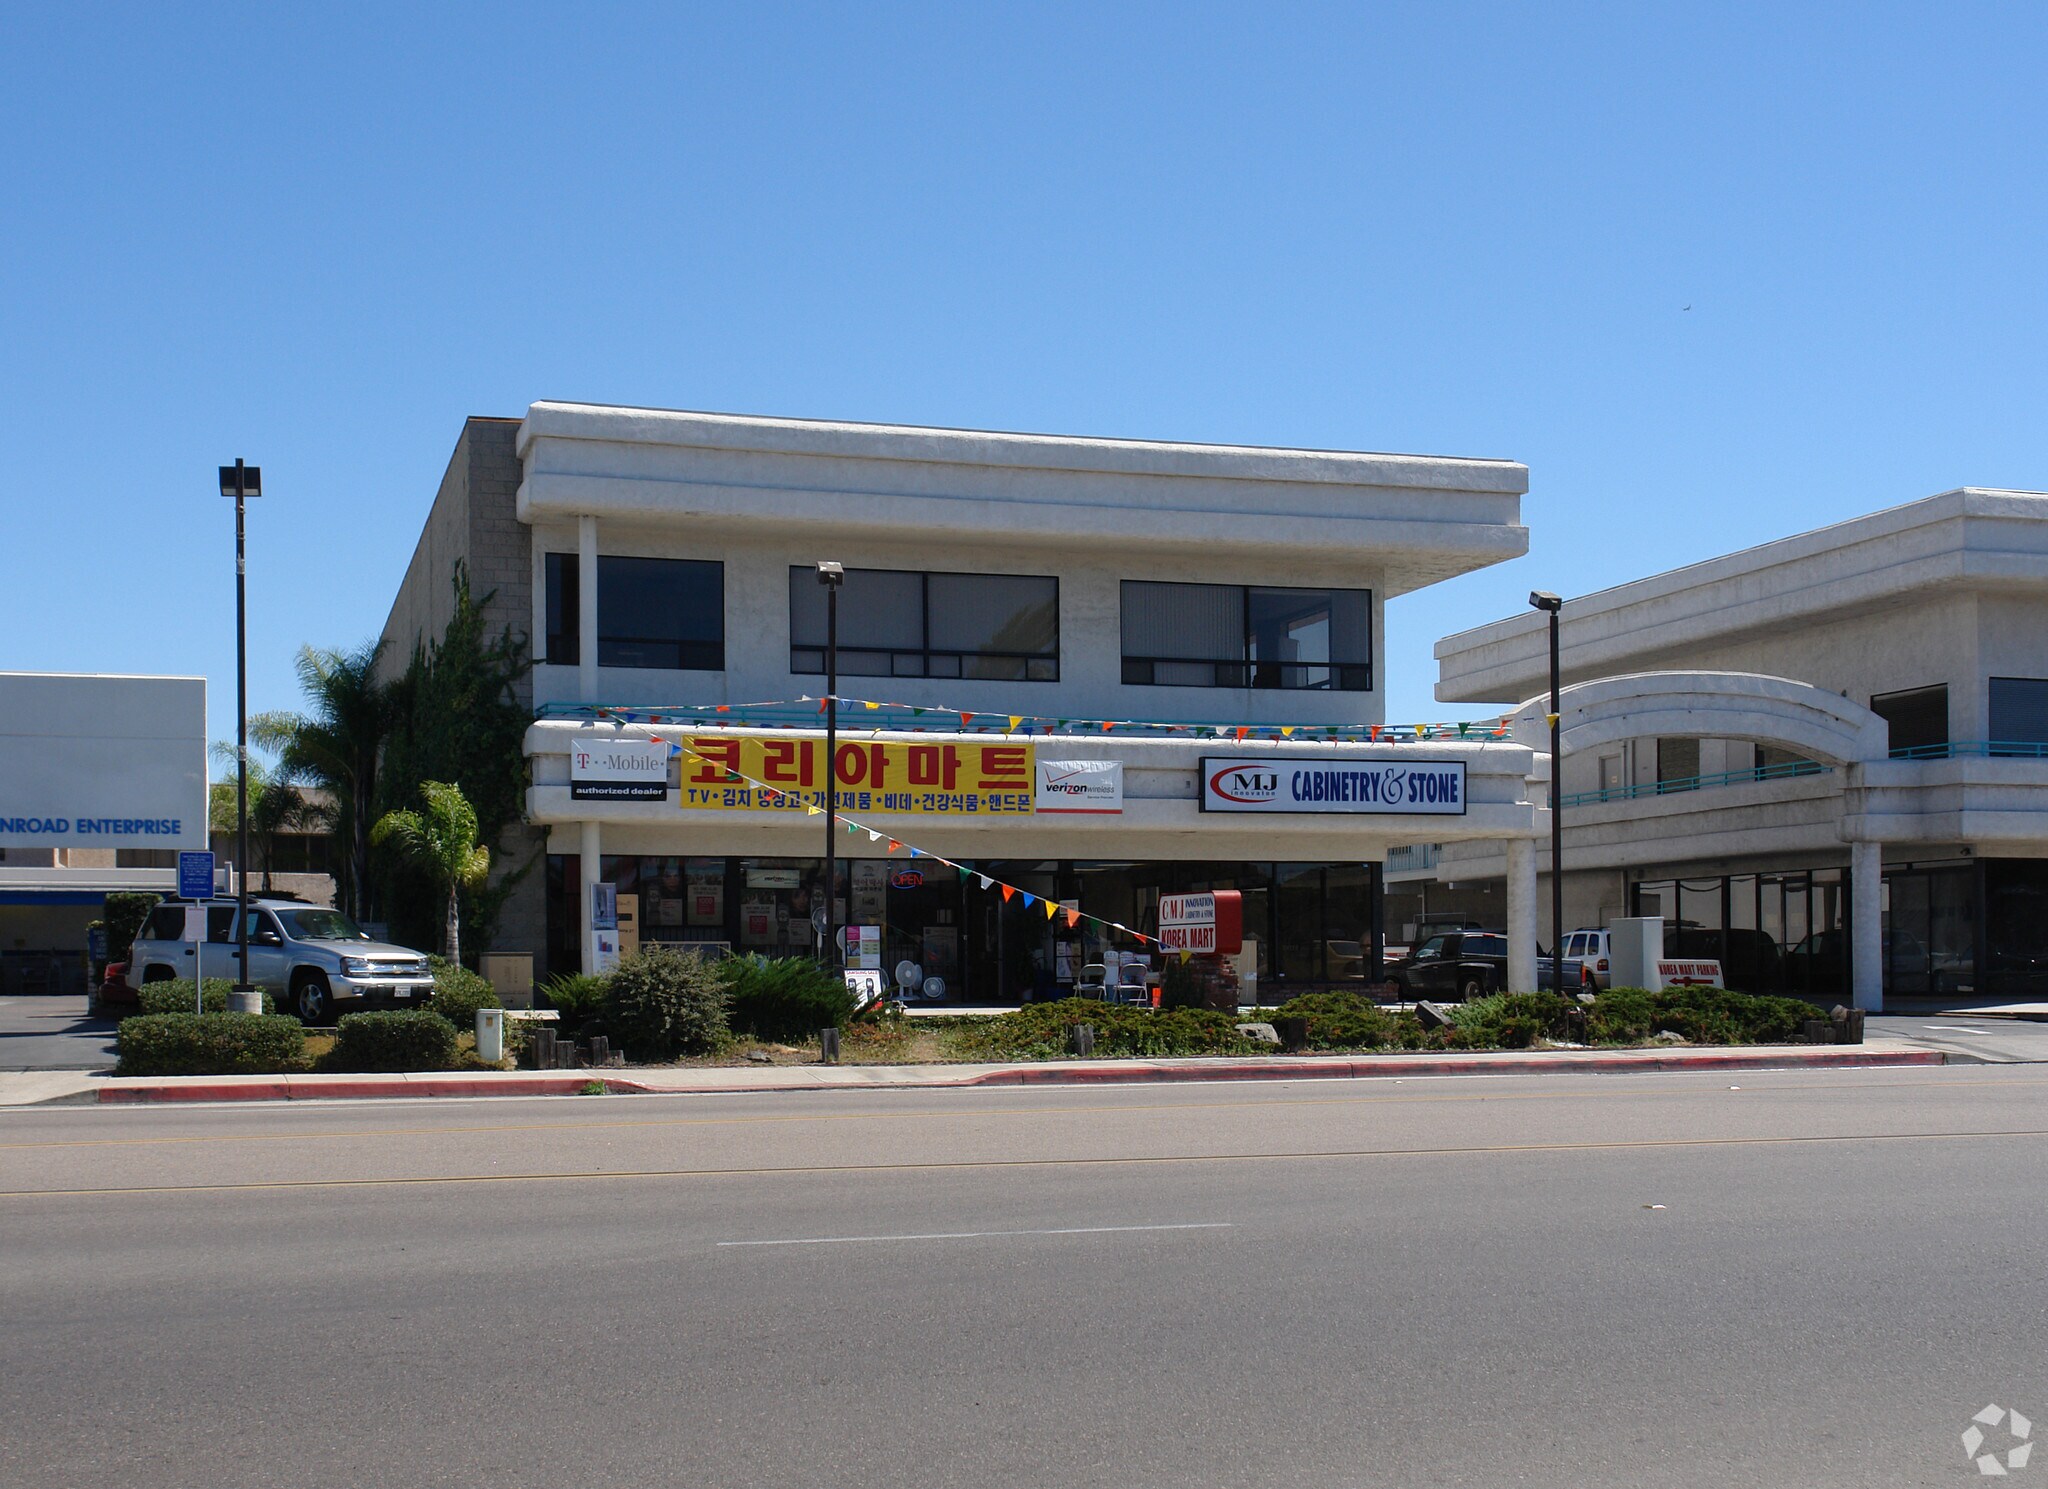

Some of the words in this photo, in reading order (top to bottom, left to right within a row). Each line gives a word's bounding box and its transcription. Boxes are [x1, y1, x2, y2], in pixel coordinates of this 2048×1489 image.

[576, 787, 630, 796] authorized
[630, 787, 664, 796] dealer
[1046, 782, 1087, 795] verizon
[1292, 770, 1380, 802] CABINETRY
[1381, 768, 1406, 805] &
[1408, 772, 1458, 803] STONE
[0, 818, 70, 833] NROAD
[77, 819, 181, 835] ENTERPRISE
[892, 873, 923, 886] OPEN
[1161, 928, 1187, 948] KOREA
[1190, 927, 1214, 948] MART
[1658, 964, 1678, 975] KOREA
[1678, 964, 1695, 975] MART
[1696, 964, 1719, 975] PARKING
